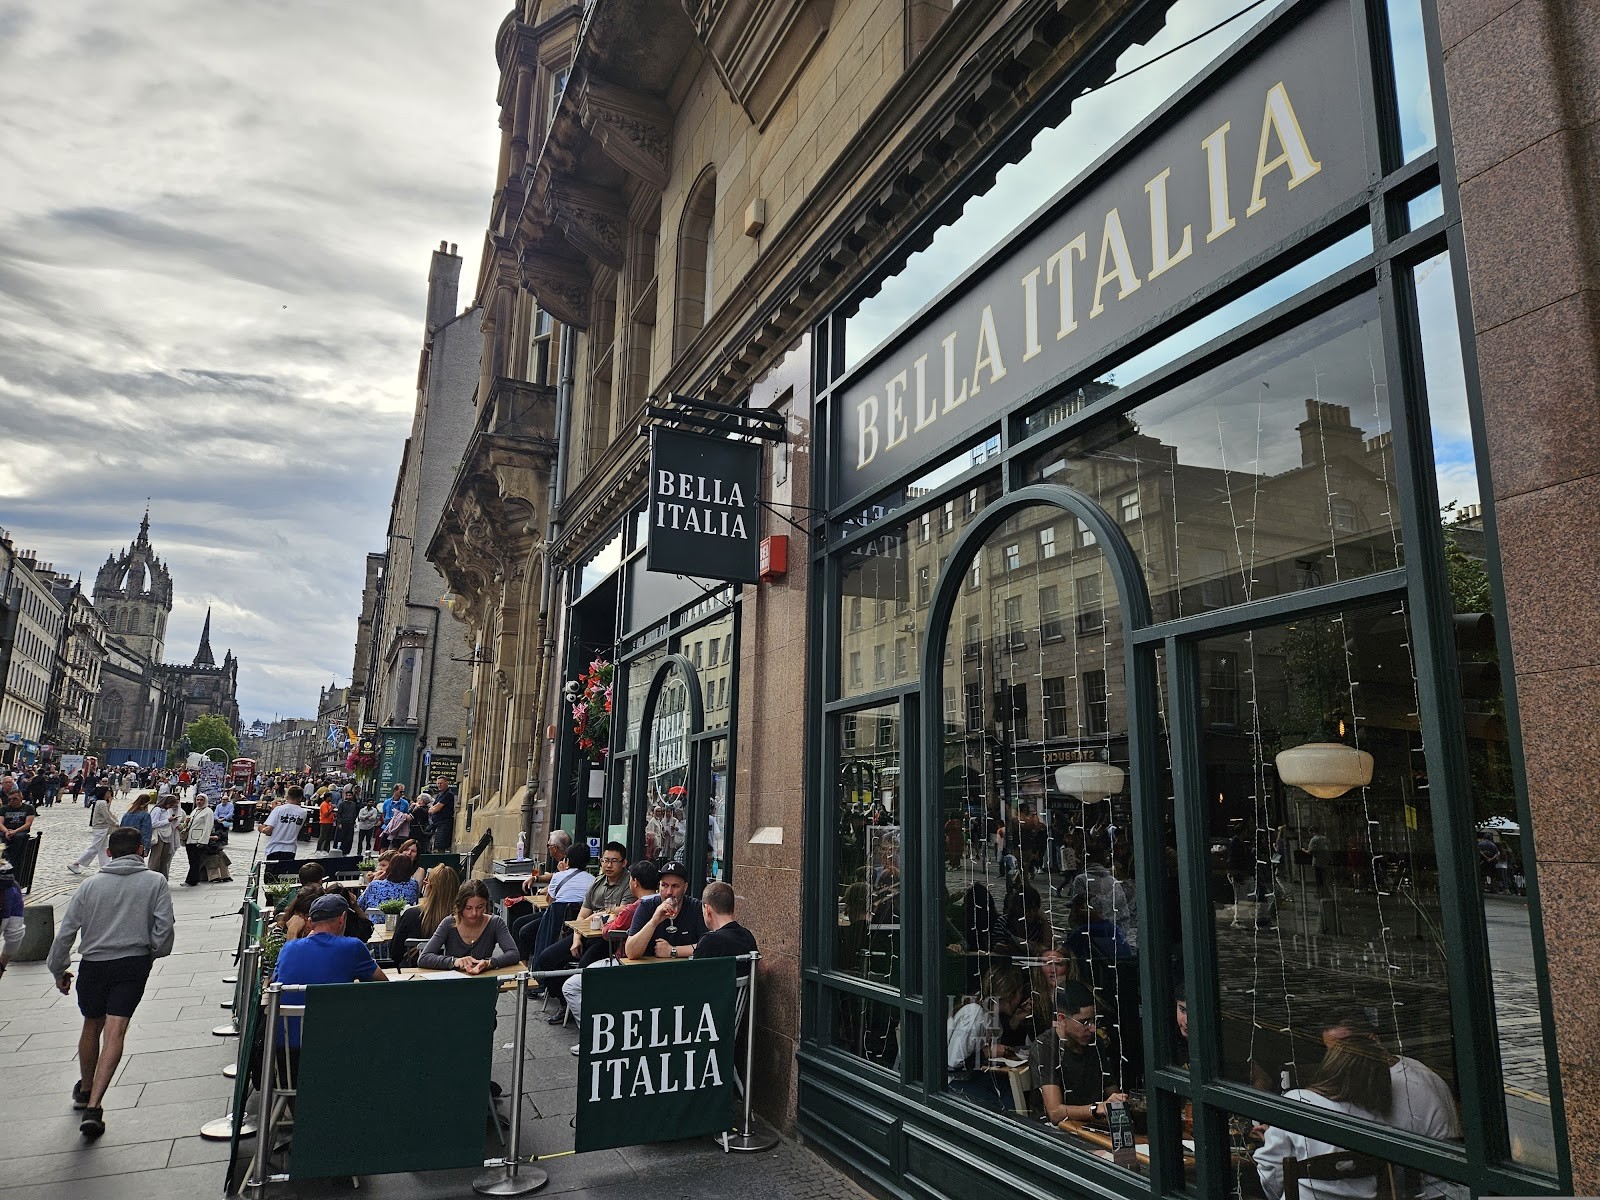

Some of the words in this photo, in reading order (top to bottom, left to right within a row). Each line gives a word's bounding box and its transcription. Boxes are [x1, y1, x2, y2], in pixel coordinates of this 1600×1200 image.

[856, 304, 1007, 471] BELLA
[1021, 80, 1322, 363] ITALIA
[657, 469, 746, 508] BELLA
[656, 502, 748, 540] ITALIA
[659, 710, 687, 743] BELLA
[658, 739, 687, 771] ITALIA
[590, 1002, 720, 1055] BELLA
[588, 1048, 724, 1103] ITALIA
